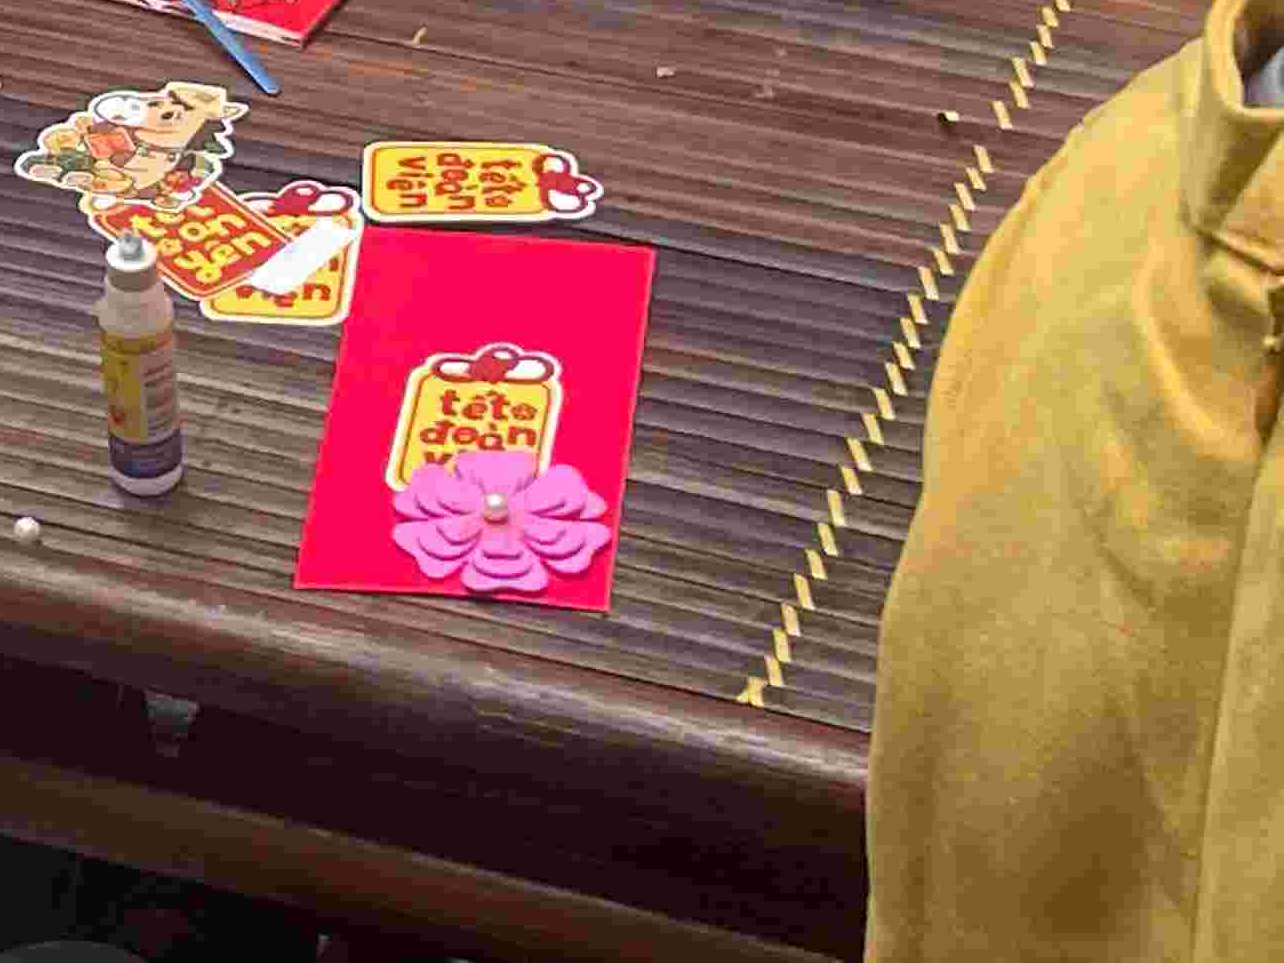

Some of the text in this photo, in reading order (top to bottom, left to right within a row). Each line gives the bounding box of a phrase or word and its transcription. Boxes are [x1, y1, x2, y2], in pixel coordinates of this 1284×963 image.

[387, 156, 434, 208] viên
[434, 153, 478, 210] đoàn
[178, 214, 247, 242] an
[172, 231, 273, 285] yên
[419, 419, 537, 452] đoàn
